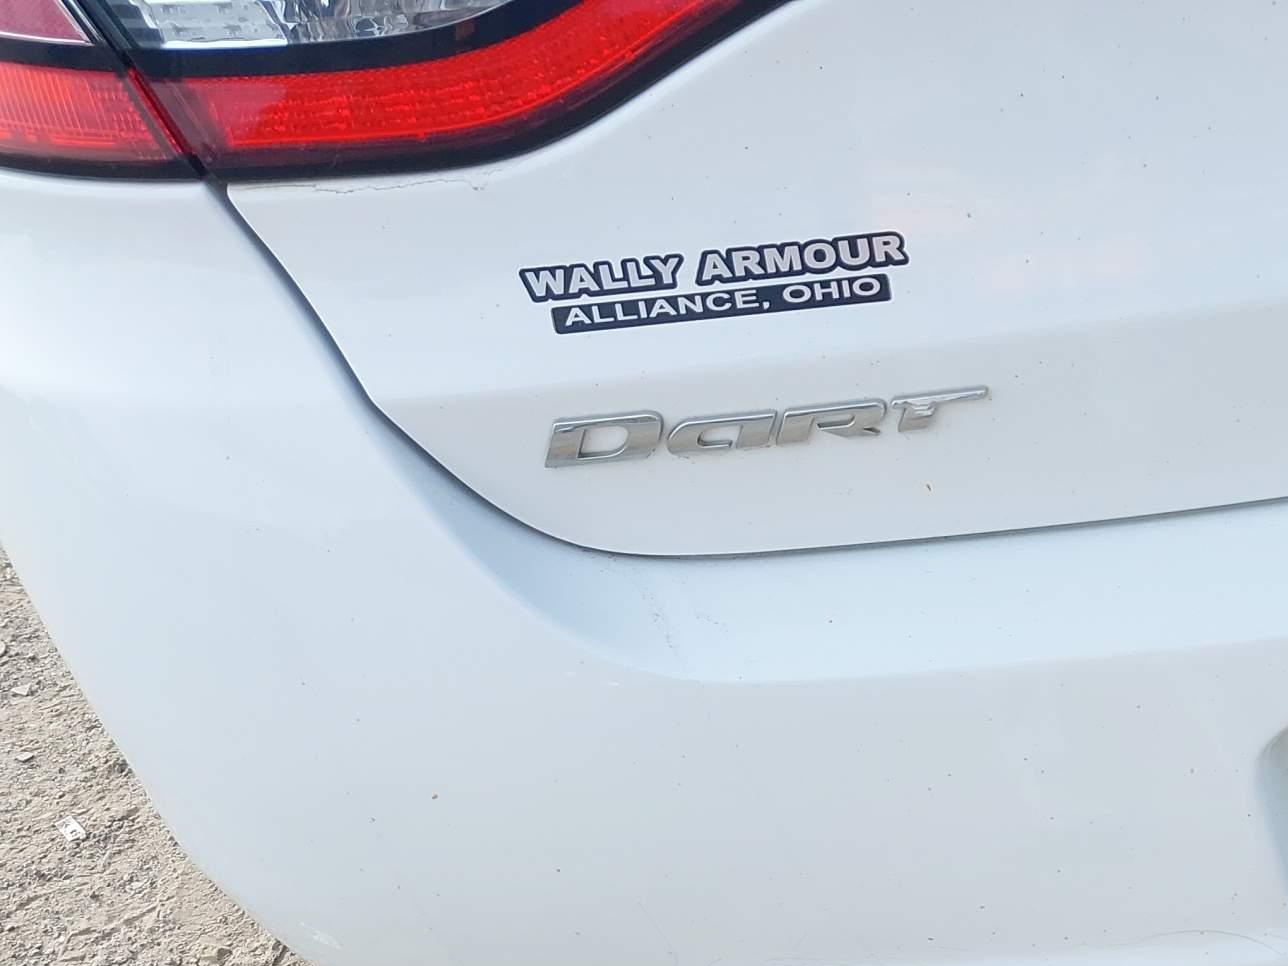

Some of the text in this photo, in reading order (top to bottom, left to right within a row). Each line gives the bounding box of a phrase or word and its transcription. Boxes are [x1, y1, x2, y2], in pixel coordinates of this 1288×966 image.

[522, 235, 905, 298] WALLY ARMOUR
[564, 276, 882, 327] ALLIANCE, OHIO
